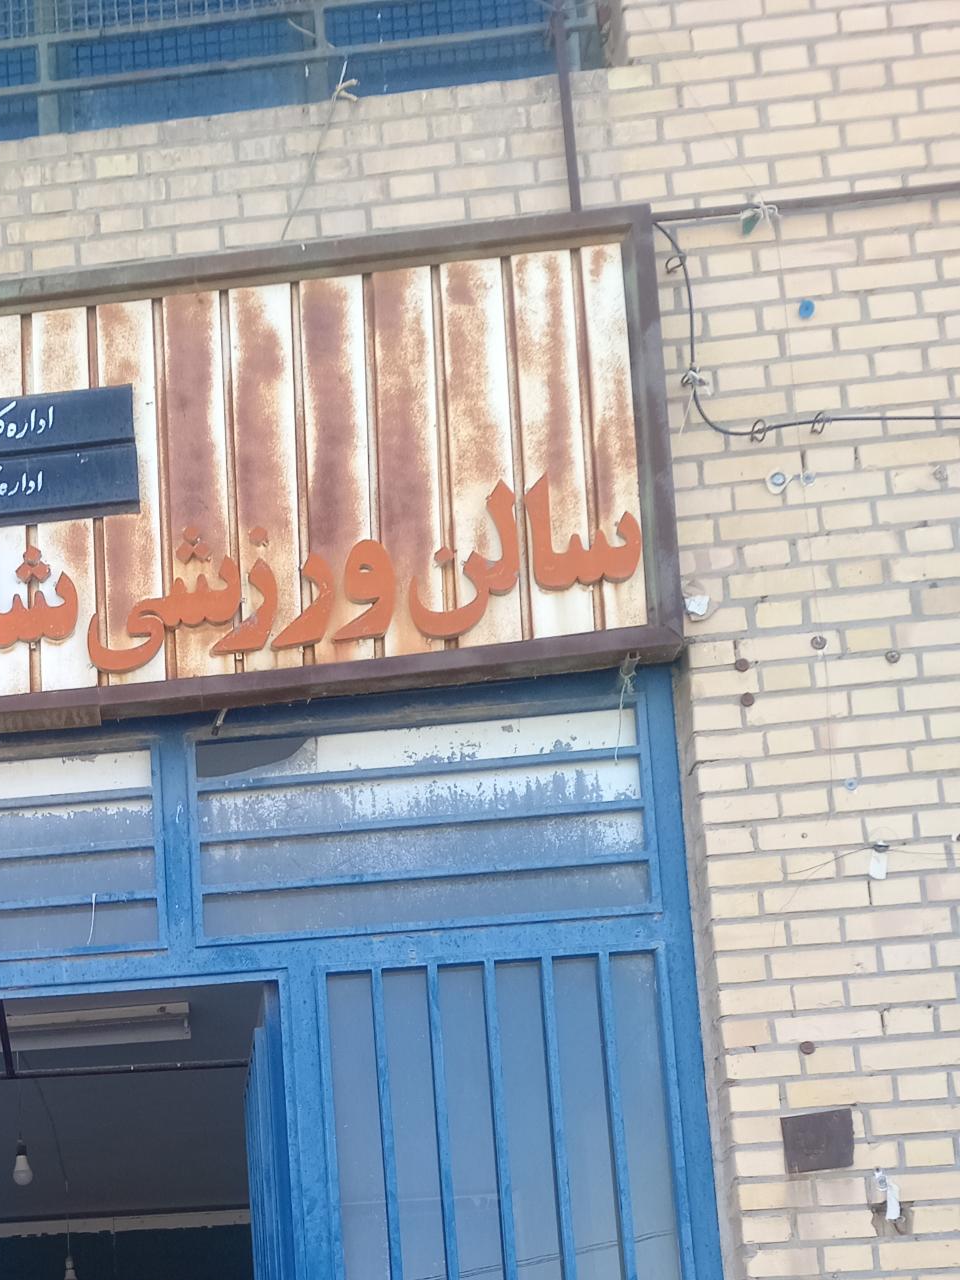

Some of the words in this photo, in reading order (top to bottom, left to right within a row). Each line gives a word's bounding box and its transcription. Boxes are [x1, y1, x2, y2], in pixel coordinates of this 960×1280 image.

[7, 405, 54, 439] اداره
[0, 471, 43, 496] اداره
[87, 524, 395, 674] ورزشی
[408, 473, 641, 639] سالن
